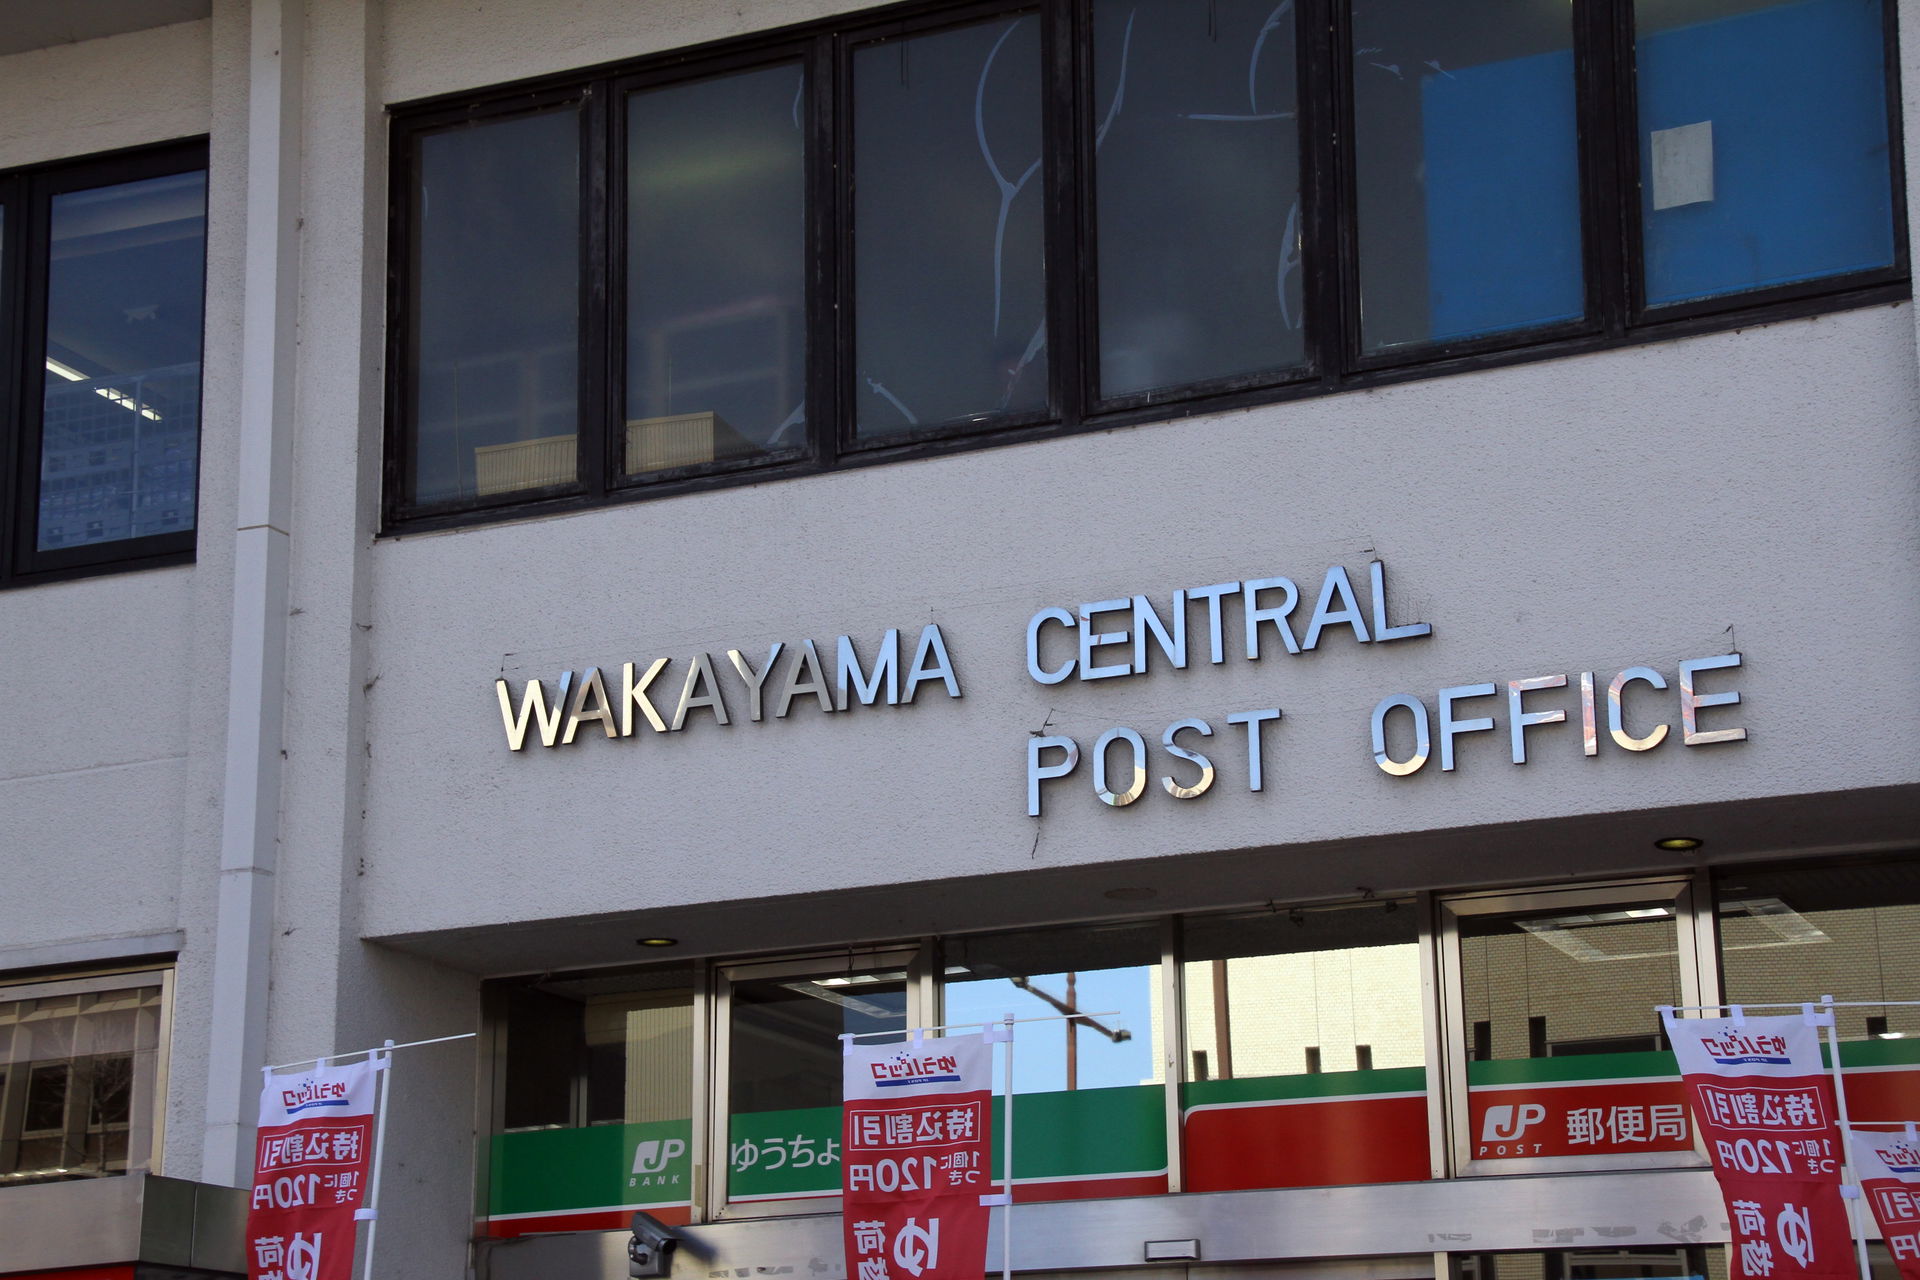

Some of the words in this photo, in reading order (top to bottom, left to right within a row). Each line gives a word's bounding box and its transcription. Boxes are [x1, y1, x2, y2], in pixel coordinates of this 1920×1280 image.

[495, 623, 962, 751] WAKAYAMA
[1026, 560, 1433, 685] CENTRAL
[1027, 708, 1282, 817] POST
[1371, 653, 1748, 776] OFFICE
[1566, 1104, 1686, 1145] 郵便局
[731, 1134, 841, 1172] ゆうちょ
[1479, 1143, 1542, 1156] POST
[629, 1174, 680, 1187] BANK
